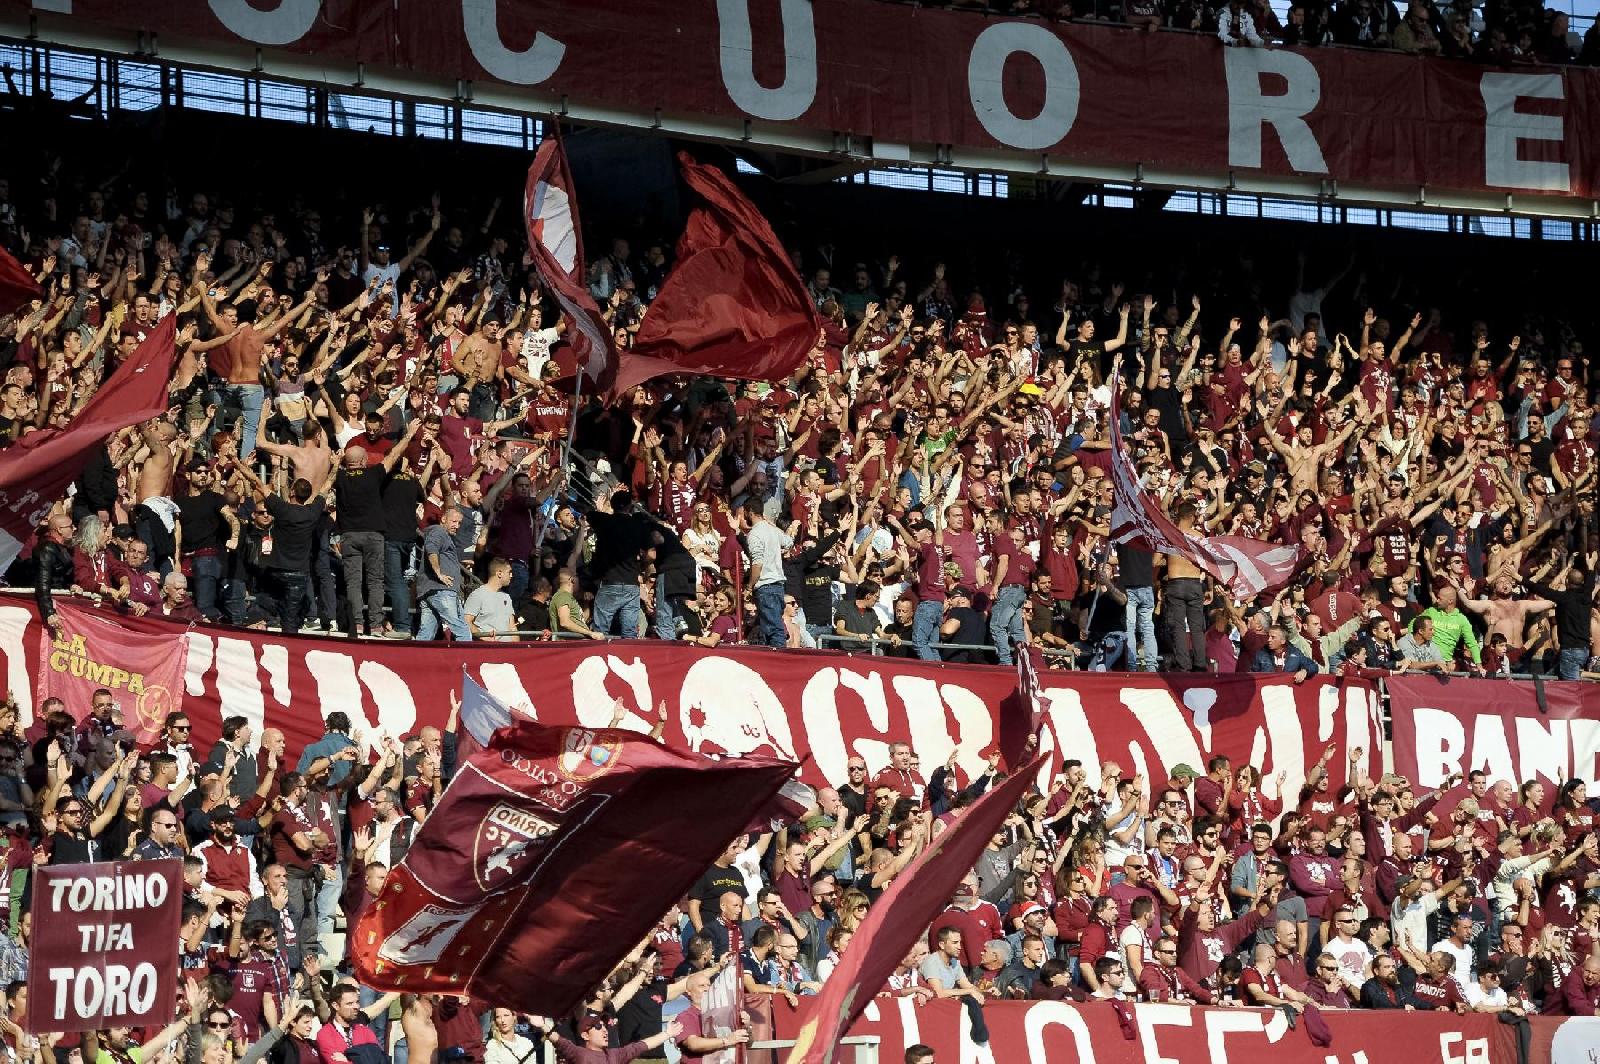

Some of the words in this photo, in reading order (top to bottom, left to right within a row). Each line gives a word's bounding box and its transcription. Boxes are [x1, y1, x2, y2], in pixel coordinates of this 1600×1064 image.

[52, 627, 88, 656] LA
[49, 651, 146, 697] CUMPA
[77, 923, 135, 953] TIFA
[49, 962, 158, 1020] TORO
